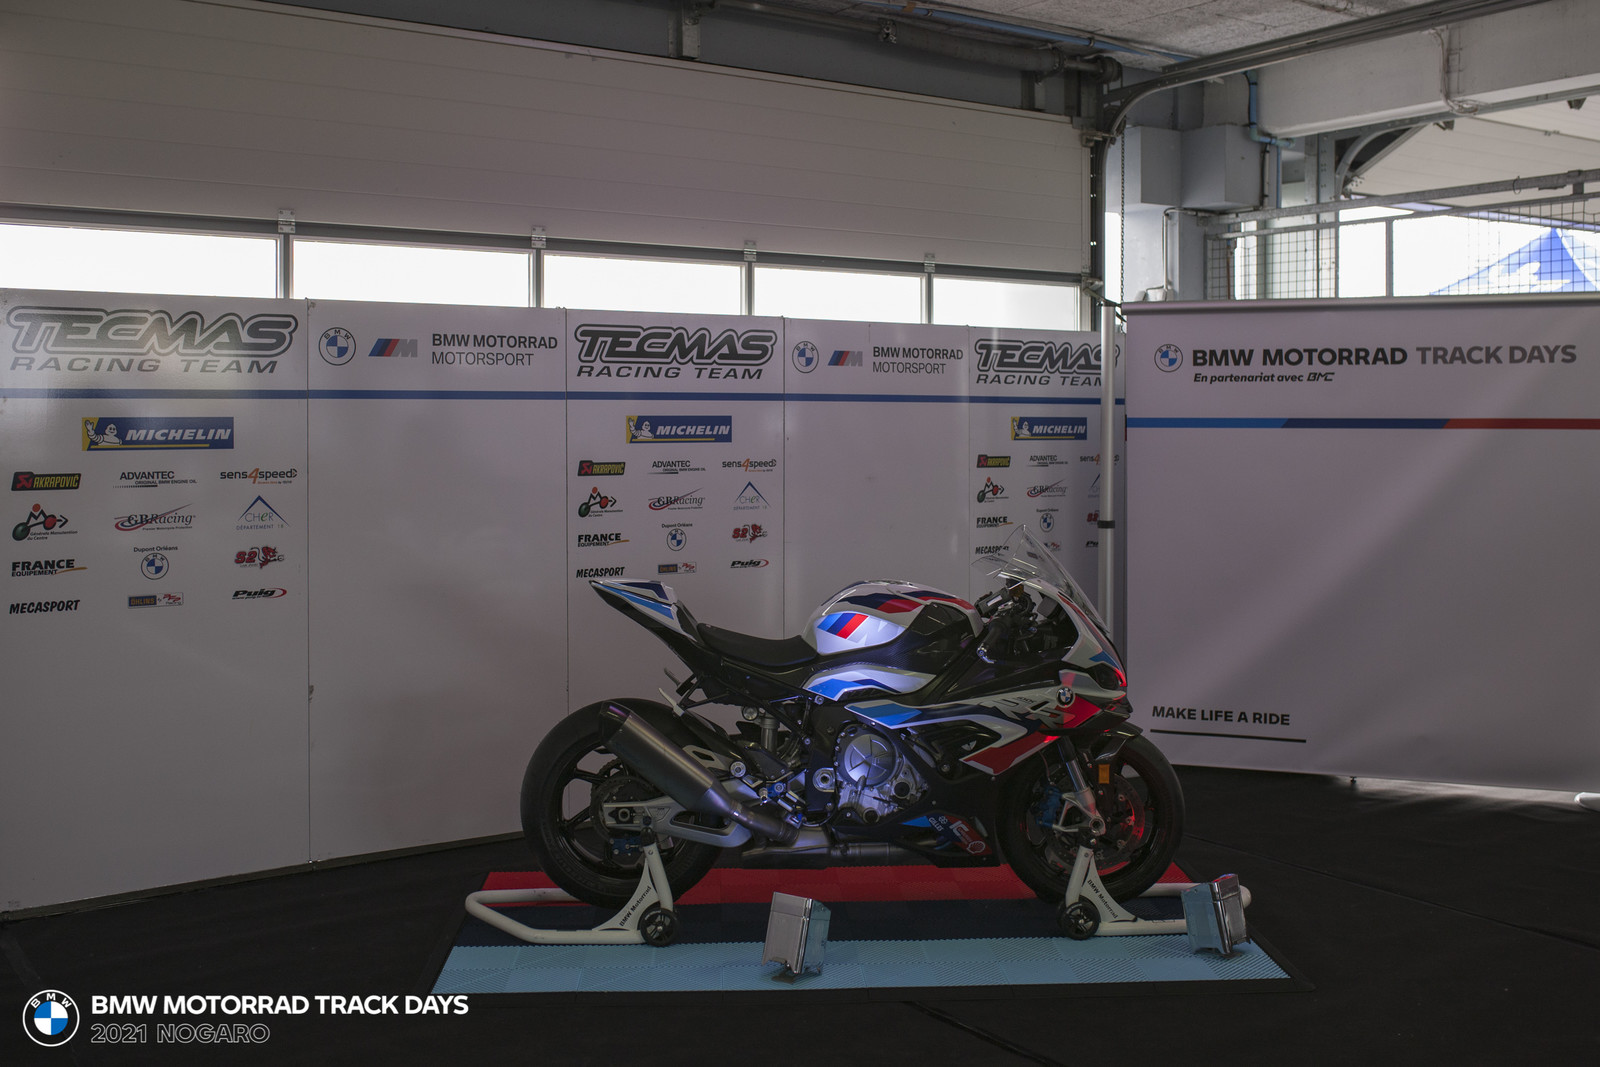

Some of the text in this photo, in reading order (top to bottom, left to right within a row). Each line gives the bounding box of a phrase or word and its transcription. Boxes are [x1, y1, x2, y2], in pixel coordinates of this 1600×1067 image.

[7, 306, 298, 357] TECMAS
[432, 333, 558, 349] BMW MOTORRAD
[574, 323, 777, 366] TECMAS
[432, 351, 534, 366] MOTORSPORT
[872, 346, 964, 360] BMW MOTORRAD
[1192, 344, 1577, 367] BMW MOTORRAD TRACK DAYS
[10, 357, 278, 374] RACING TEAM
[872, 361, 946, 374] MOTORSPORT
[577, 365, 763, 380] RACING TEAM
[1193, 373, 1208, 383] En
[1210, 372, 1275, 385] partenariat
[1277, 374, 1304, 383] avec
[976, 373, 1050, 386] RACING
[125, 428, 232, 441] MICHELIN
[656, 425, 730, 435] MICHELIN
[1032, 425, 1086, 434] MICHELIN
[652, 460, 691, 468] ADVANTEC
[120, 471, 175, 480] ADVANTEC
[220, 467, 293, 484] sens4speed
[976, 516, 1008, 525] FRANCE
[578, 533, 621, 543] FRANCE
[12, 559, 75, 571] FRANCE
[12, 569, 58, 577] EQUIPEMENT
[576, 567, 625, 578] MECASPORT
[9, 600, 80, 614] MECASPORT
[1152, 705, 1290, 726] MAKE LIFE A RIDE
[619, 885, 652, 927] BMW Motorrad
